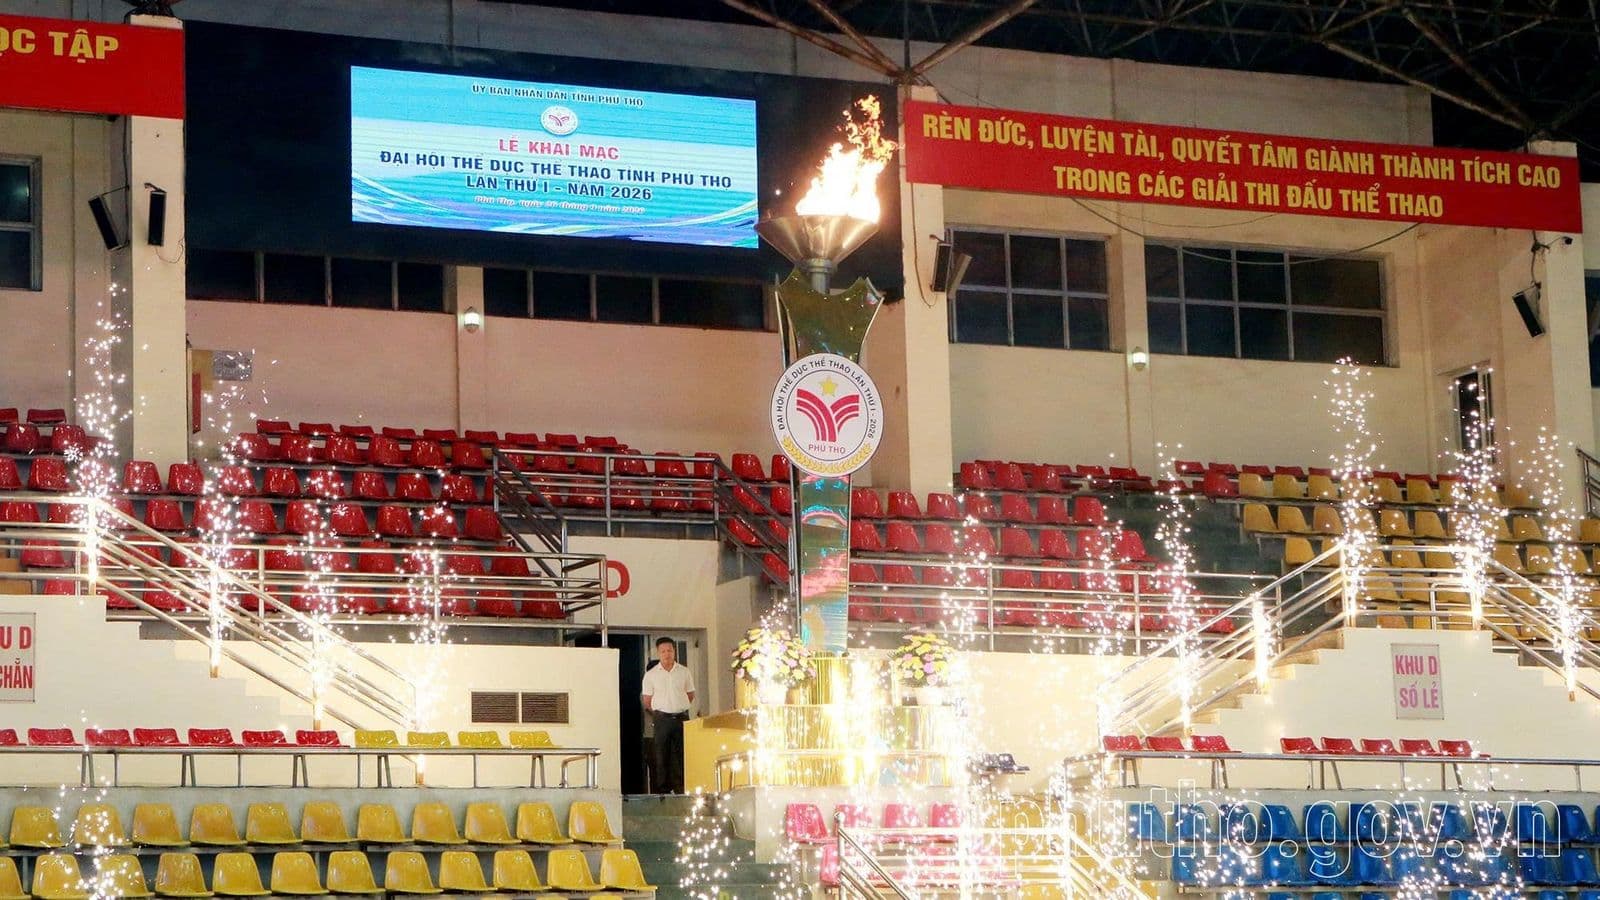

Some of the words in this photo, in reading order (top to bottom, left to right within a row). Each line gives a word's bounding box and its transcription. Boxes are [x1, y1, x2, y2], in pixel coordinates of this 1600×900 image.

[48, 29, 119, 63] TẬP
[528, 141, 570, 156] KHAI
[579, 145, 620, 161] MẠC
[922, 110, 971, 141] RÈN
[978, 116, 1034, 149] ĐỨC,
[1041, 124, 1114, 157] LUYỆN
[1121, 129, 1165, 161] TÀI,
[1171, 135, 1242, 165] QUYẾT
[1248, 140, 1298, 169] TÂM
[1305, 146, 1374, 175] GIÀNH
[1381, 151, 1455, 181] THÀNH
[1461, 156, 1511, 185] TÍCH
[1517, 164, 1561, 189] CAO
[380, 151, 409, 166] ĐẠI
[416, 151, 446, 169] HỘI
[490, 159, 524, 175] DỤC
[568, 164, 611, 180] THAO
[700, 174, 732, 191] THỌ
[543, 181, 548, 193] I
[611, 186, 652, 200] 2026
[1053, 165, 1131, 195] TRONG
[1138, 169, 1185, 199] CÁC
[1192, 172, 1238, 203] GIẢI
[1244, 180, 1280, 207] THI
[1287, 179, 1332, 210] ĐẤU
[1339, 182, 1380, 214] THỂ
[1386, 192, 1444, 218] THAO
[829, 359, 851, 374] THAO
[867, 418, 877, 439] 2026
[19, 626, 32, 649] D
[1395, 654, 1424, 675] KHU
[1428, 655, 1438, 675] D
[1399, 680, 1419, 709] SỐ
[1422, 681, 1440, 709] LẺ
